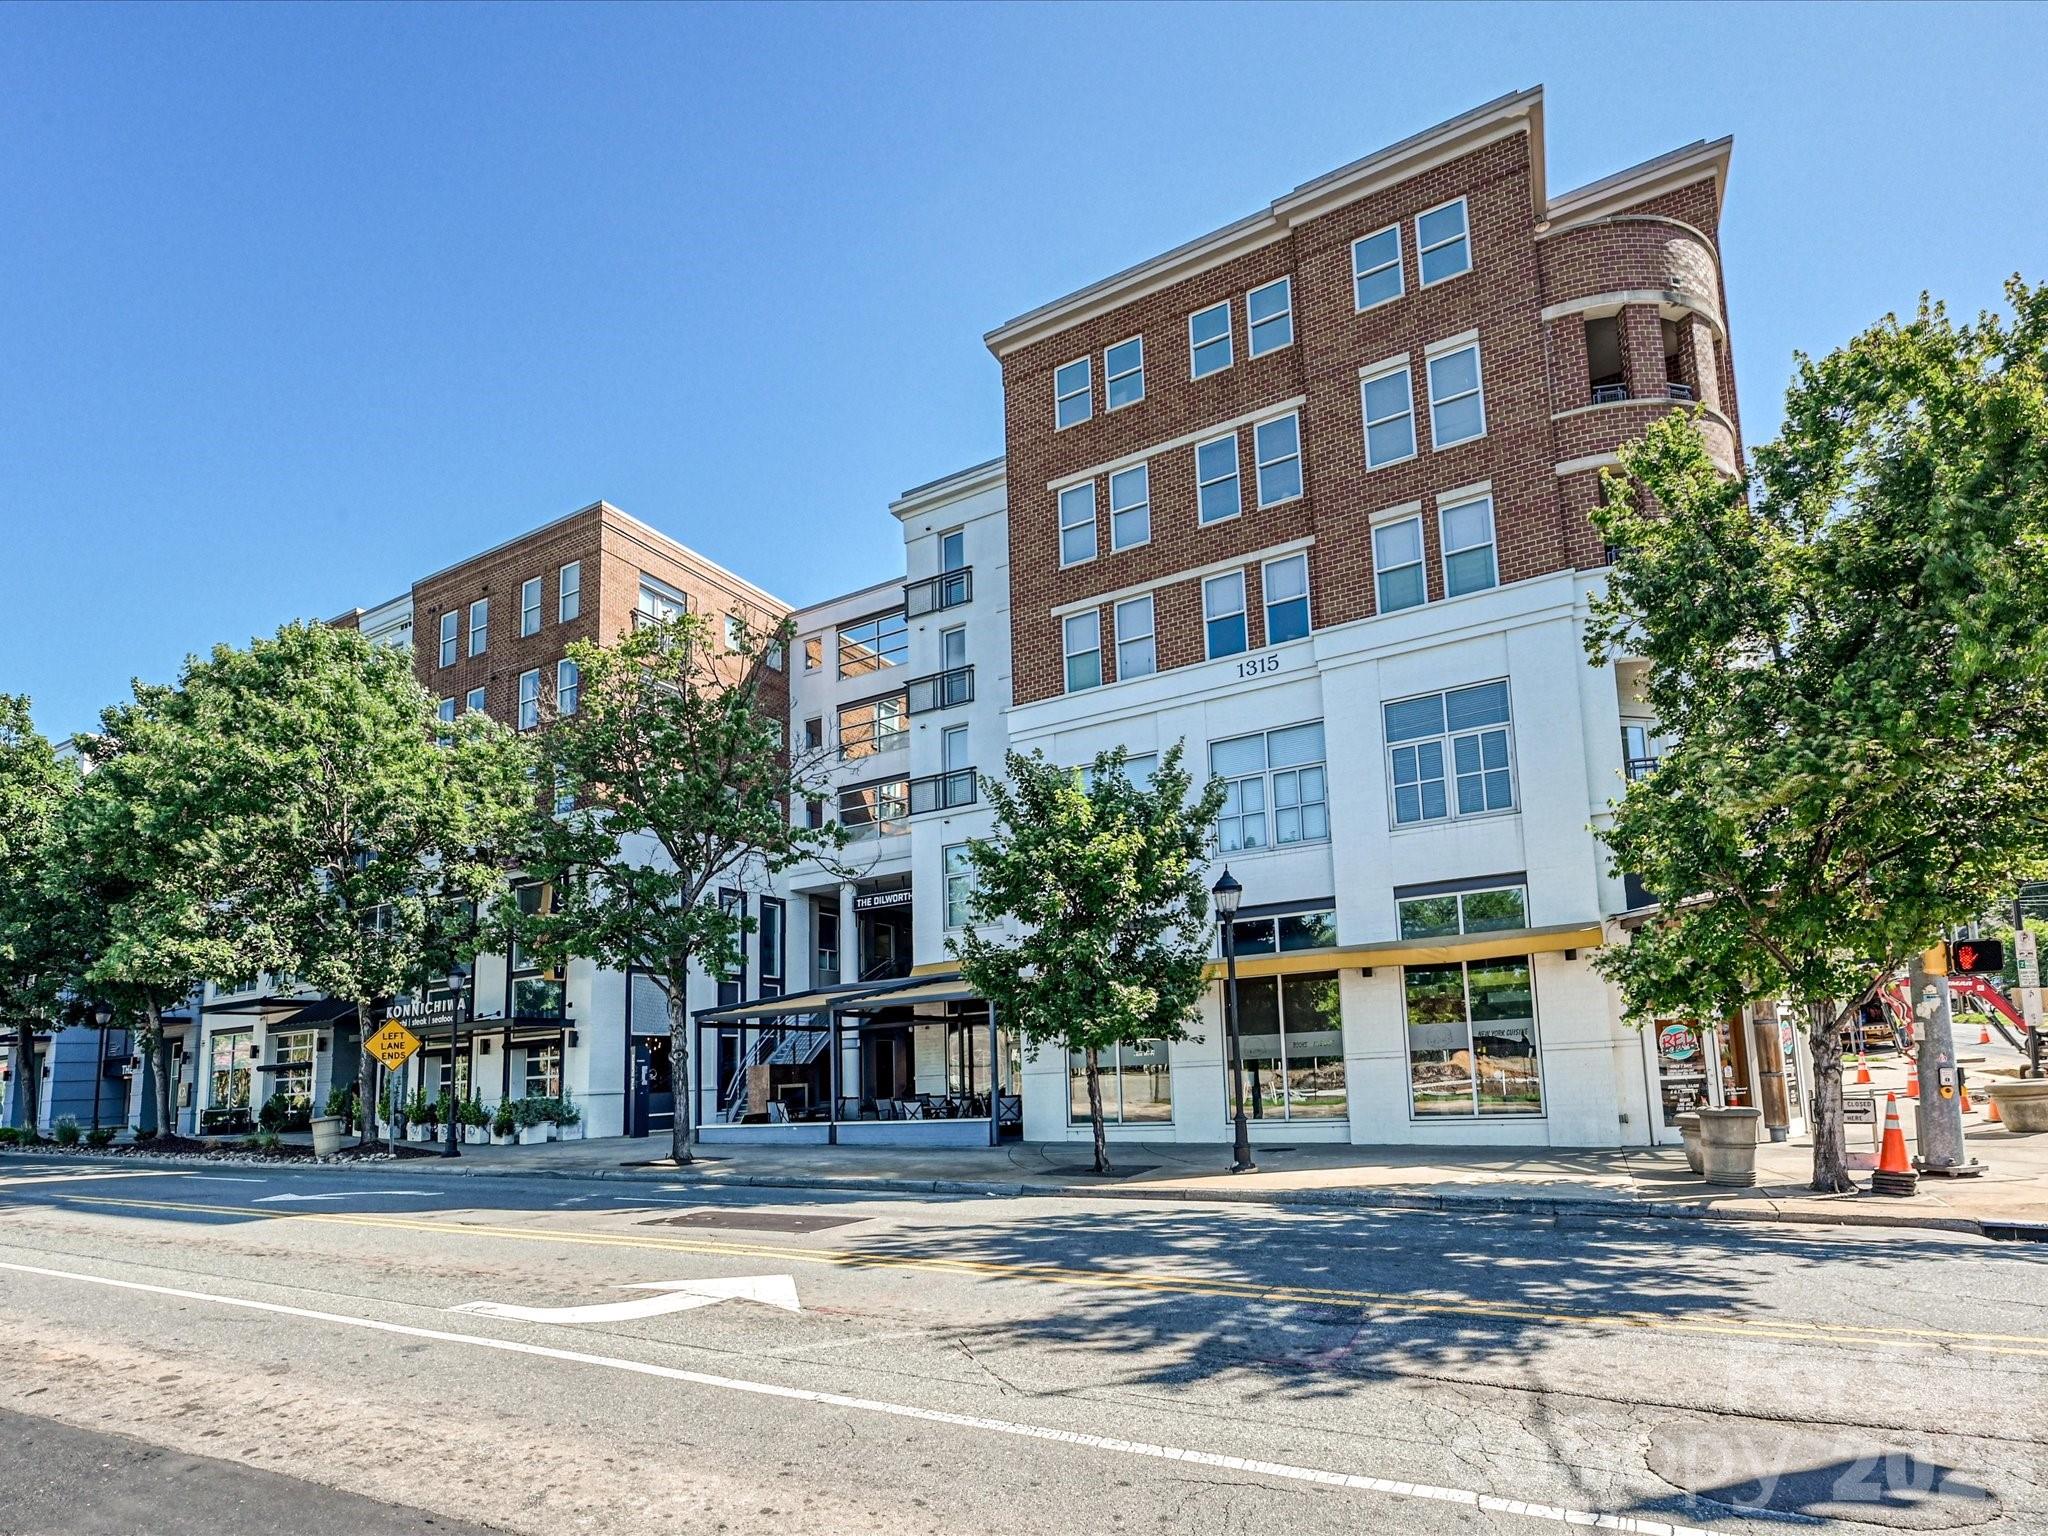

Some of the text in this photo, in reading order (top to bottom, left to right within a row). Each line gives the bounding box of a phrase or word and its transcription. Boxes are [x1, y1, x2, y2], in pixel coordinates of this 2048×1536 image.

[1237, 653, 1279, 678] 1315
[857, 892, 913, 908] THE DILWORTH
[382, 1032, 405, 1041] LEFT
[380, 1042, 406, 1051] LANE
[381, 1052, 406, 1060] ENDS
